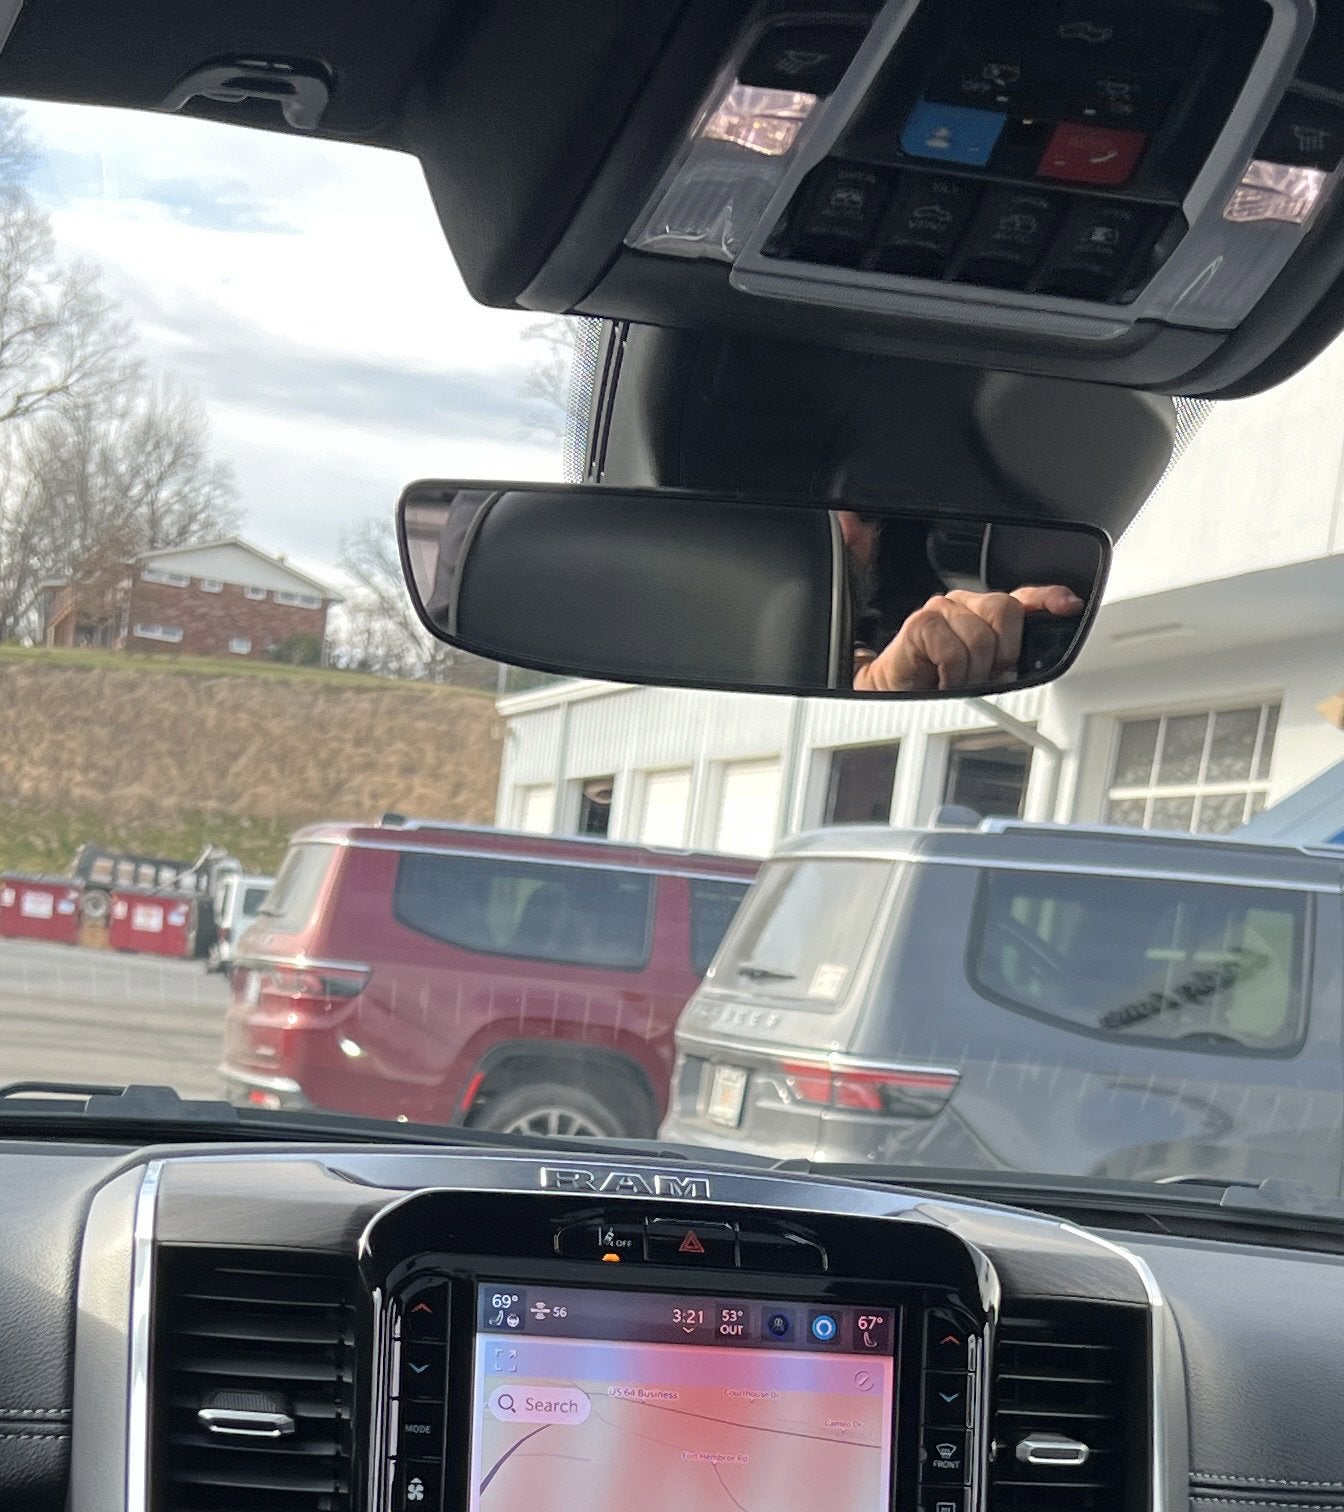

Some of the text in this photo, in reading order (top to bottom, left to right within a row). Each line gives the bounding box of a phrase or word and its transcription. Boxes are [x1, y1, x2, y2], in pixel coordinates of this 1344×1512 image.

[540, 1166, 711, 1199] RAM
[552, 1306, 568, 1318] 56
[672, 1309, 704, 1324] 3:21
[720, 1325, 744, 1335] OUT
[609, 1387, 622, 1397] US
[637, 1389, 678, 1400] Business
[525, 1398, 579, 1414] Search
[405, 1424, 431, 1434] MODE
[932, 1460, 960, 1469] FRONT
